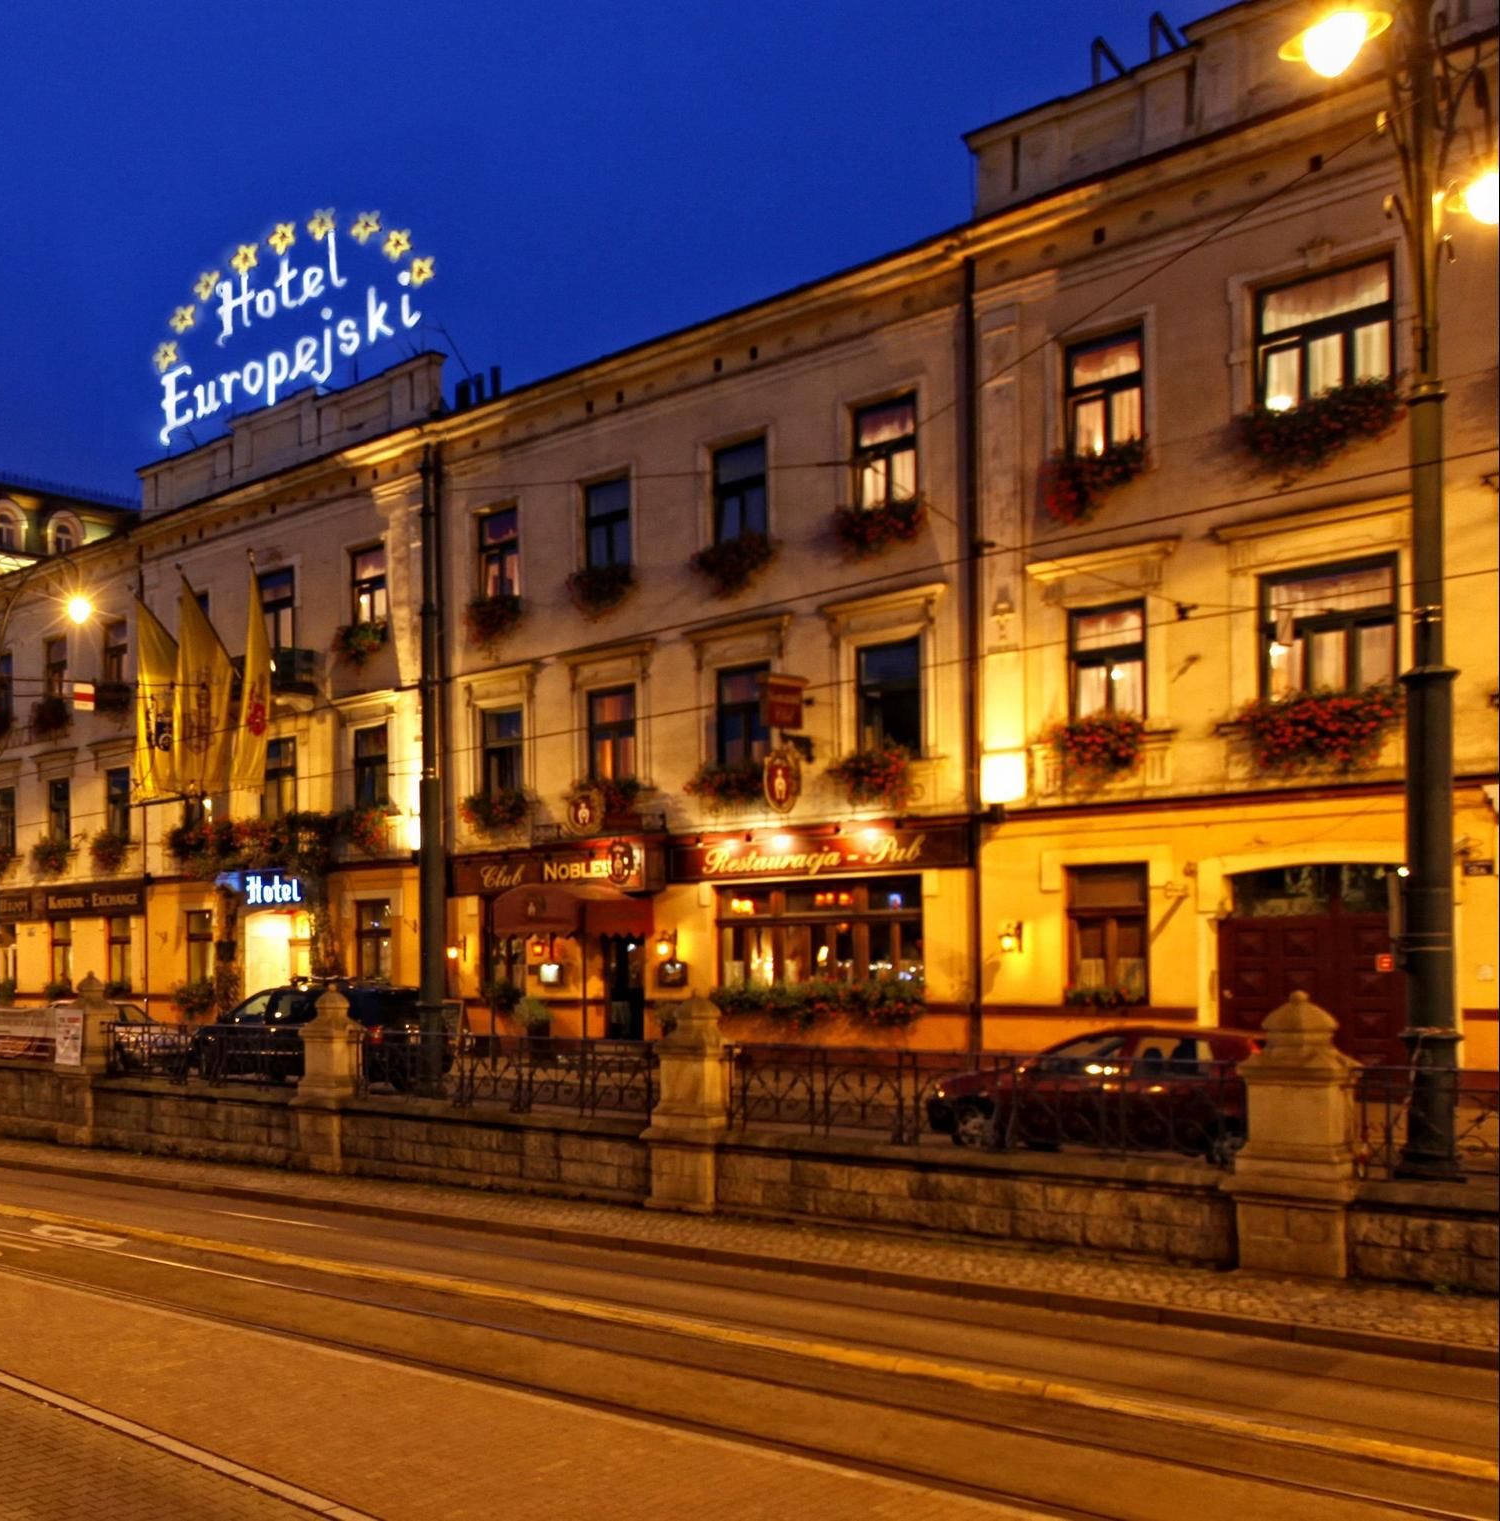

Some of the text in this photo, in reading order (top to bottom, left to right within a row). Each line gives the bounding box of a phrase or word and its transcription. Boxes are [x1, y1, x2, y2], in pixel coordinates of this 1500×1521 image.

[216, 229, 346, 345] Hotel
[160, 271, 421, 445] Europejski
[702, 846, 841, 875] Restauracja
[865, 833, 925, 864] Pub
[246, 875, 302, 904] Hotel
[480, 863, 524, 888] Club
